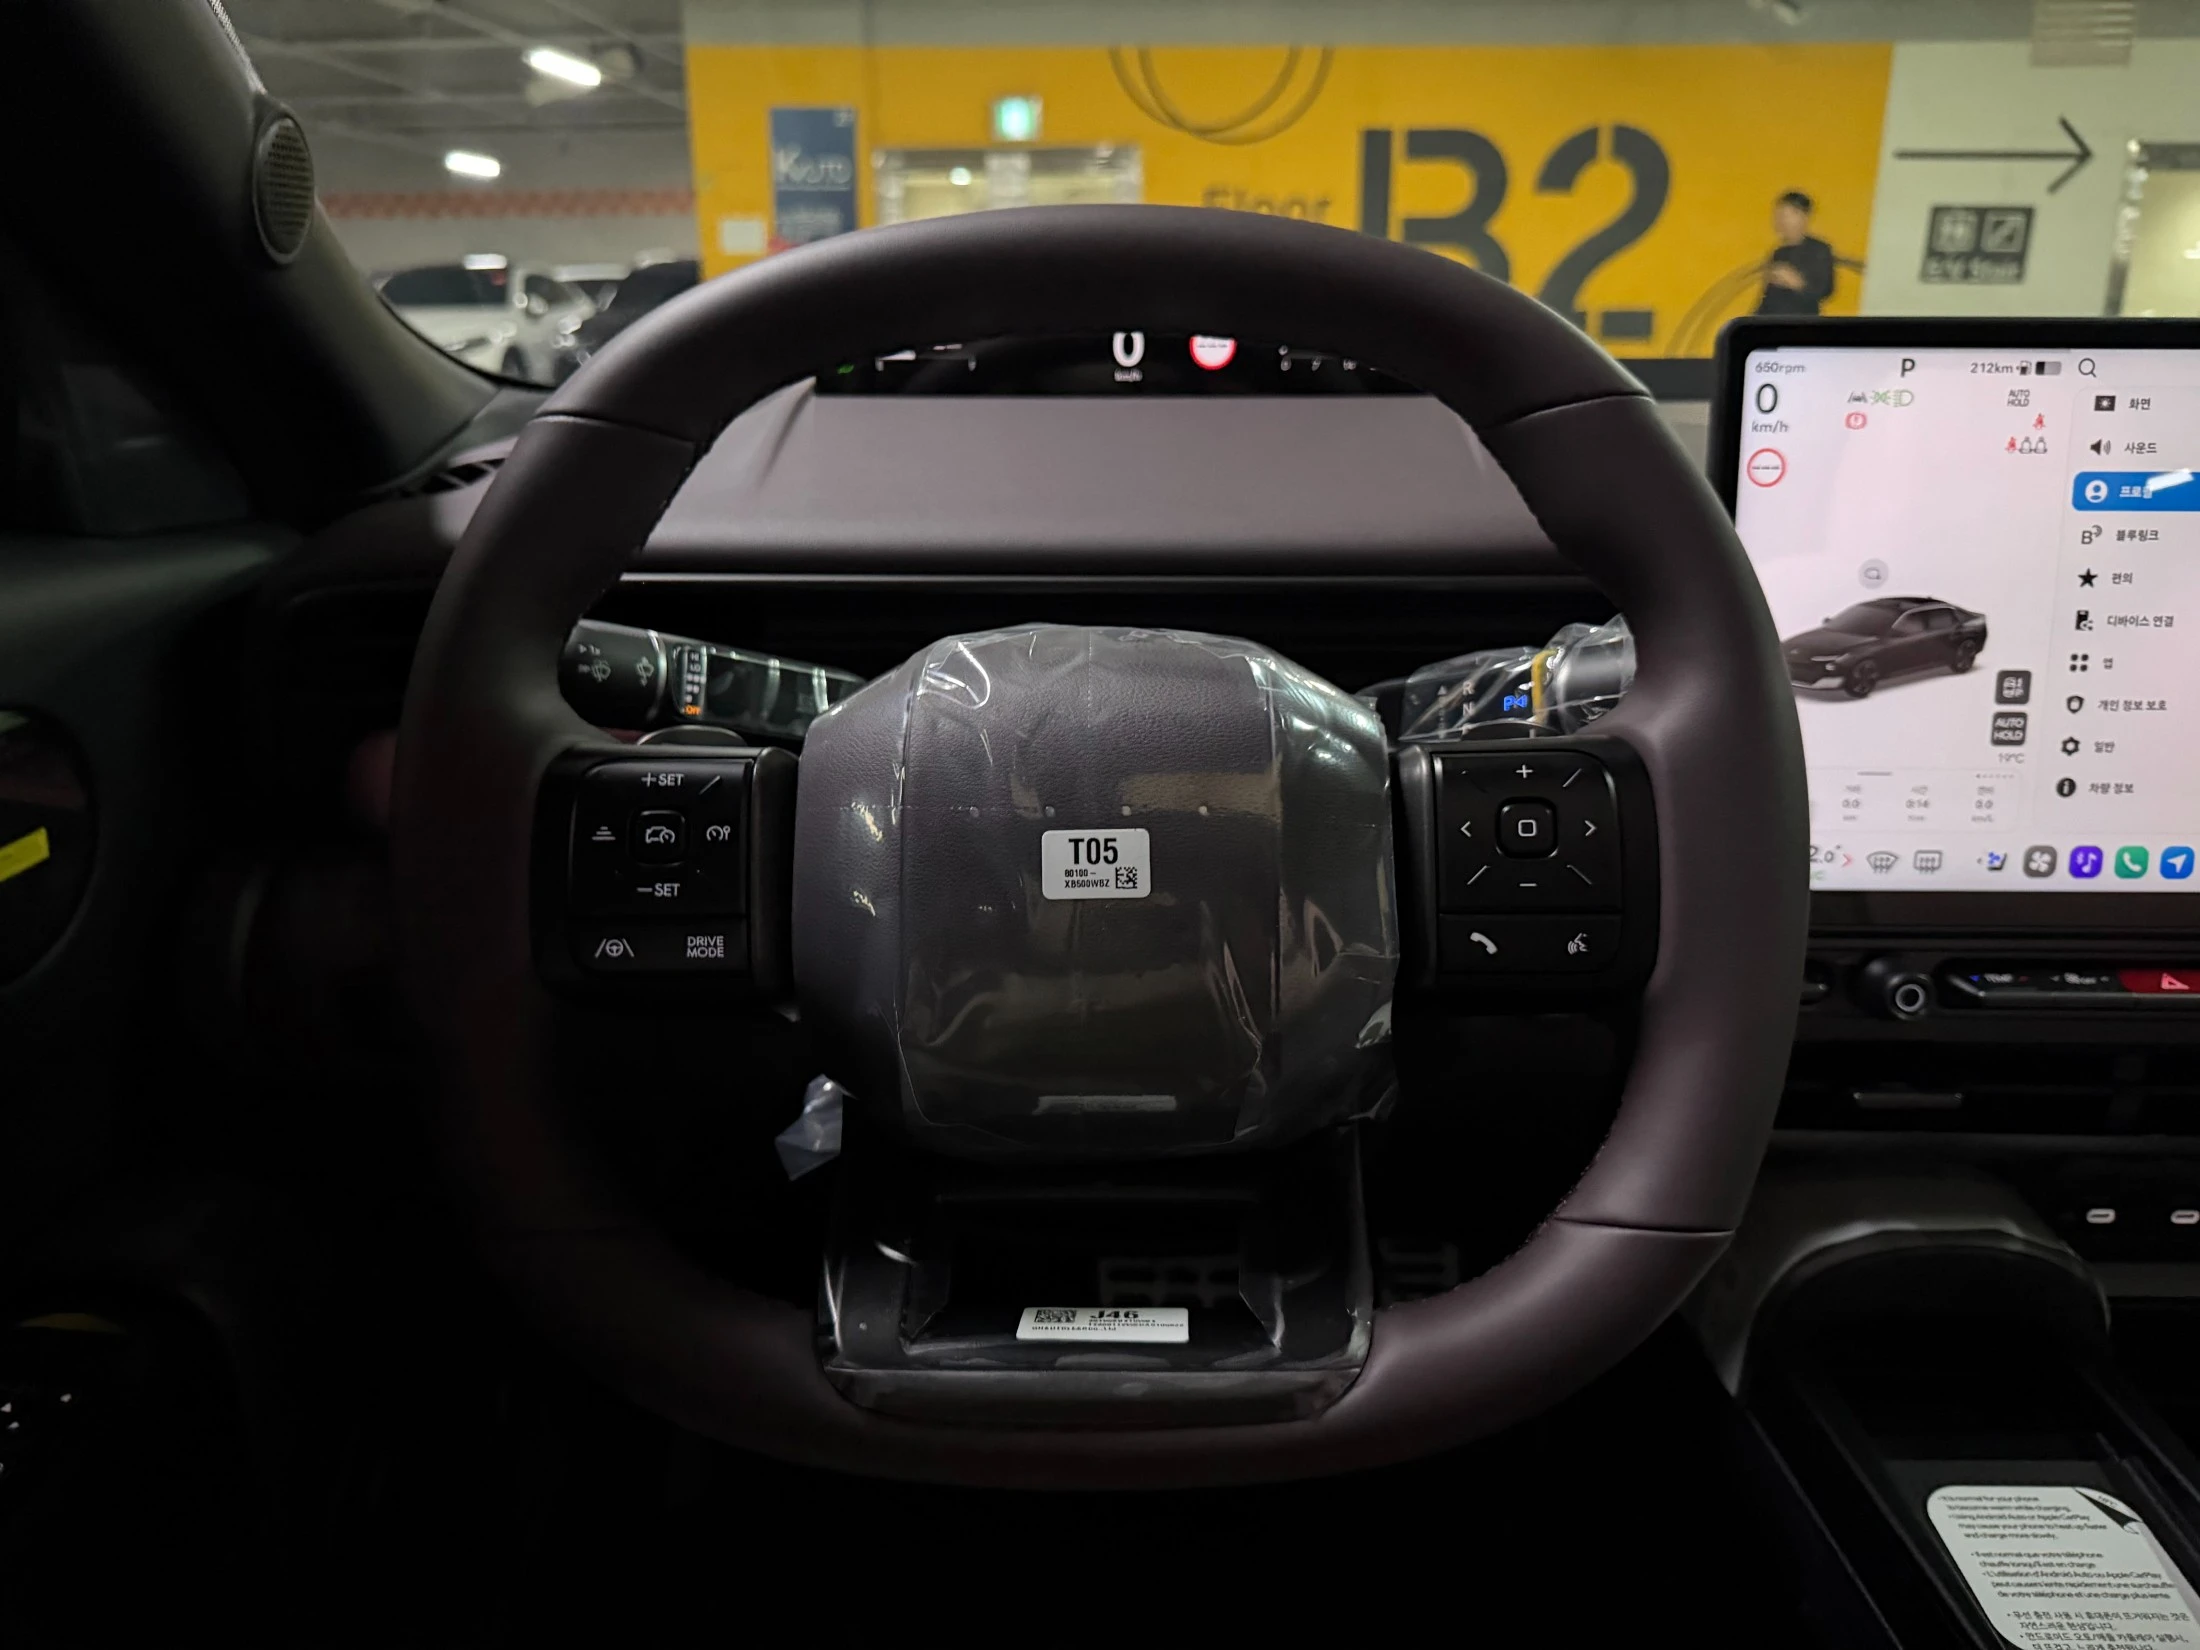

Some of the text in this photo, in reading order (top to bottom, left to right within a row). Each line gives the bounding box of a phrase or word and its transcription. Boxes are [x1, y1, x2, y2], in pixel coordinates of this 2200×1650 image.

[1359, 122, 1674, 338] B2
[1755, 362, 1806, 374] 650rpm
[1900, 358, 1916, 378] P
[1970, 362, 2013, 374] 212km
[1755, 382, 1779, 414] 0
[2008, 389, 2030, 398] AUTO
[2007, 398, 2029, 407] HOLD
[2129, 398, 2151, 410] 화면
[1751, 420, 1790, 433] km/h
[2124, 442, 2157, 454] 사운드
[2116, 529, 2159, 541] 블루링크
[2111, 572, 2133, 584] 편의
[2106, 615, 2174, 628] 디바이스 연결
[1462, 682, 1474, 695] R
[1462, 702, 1475, 714] N
[2098, 699, 2119, 711] 개인
[2122, 700, 2143, 711] 정보
[1995, 717, 2025, 728] AUTO
[1993, 729, 2024, 740] HOLD
[2094, 741, 2115, 753] 일반
[2089, 782, 2134, 794] 차량 정보
[1068, 837, 1119, 865] T05
[687, 936, 724, 947] DRIVE
[686, 947, 724, 958] MODE
[1090, 1310, 1139, 1319] J46
